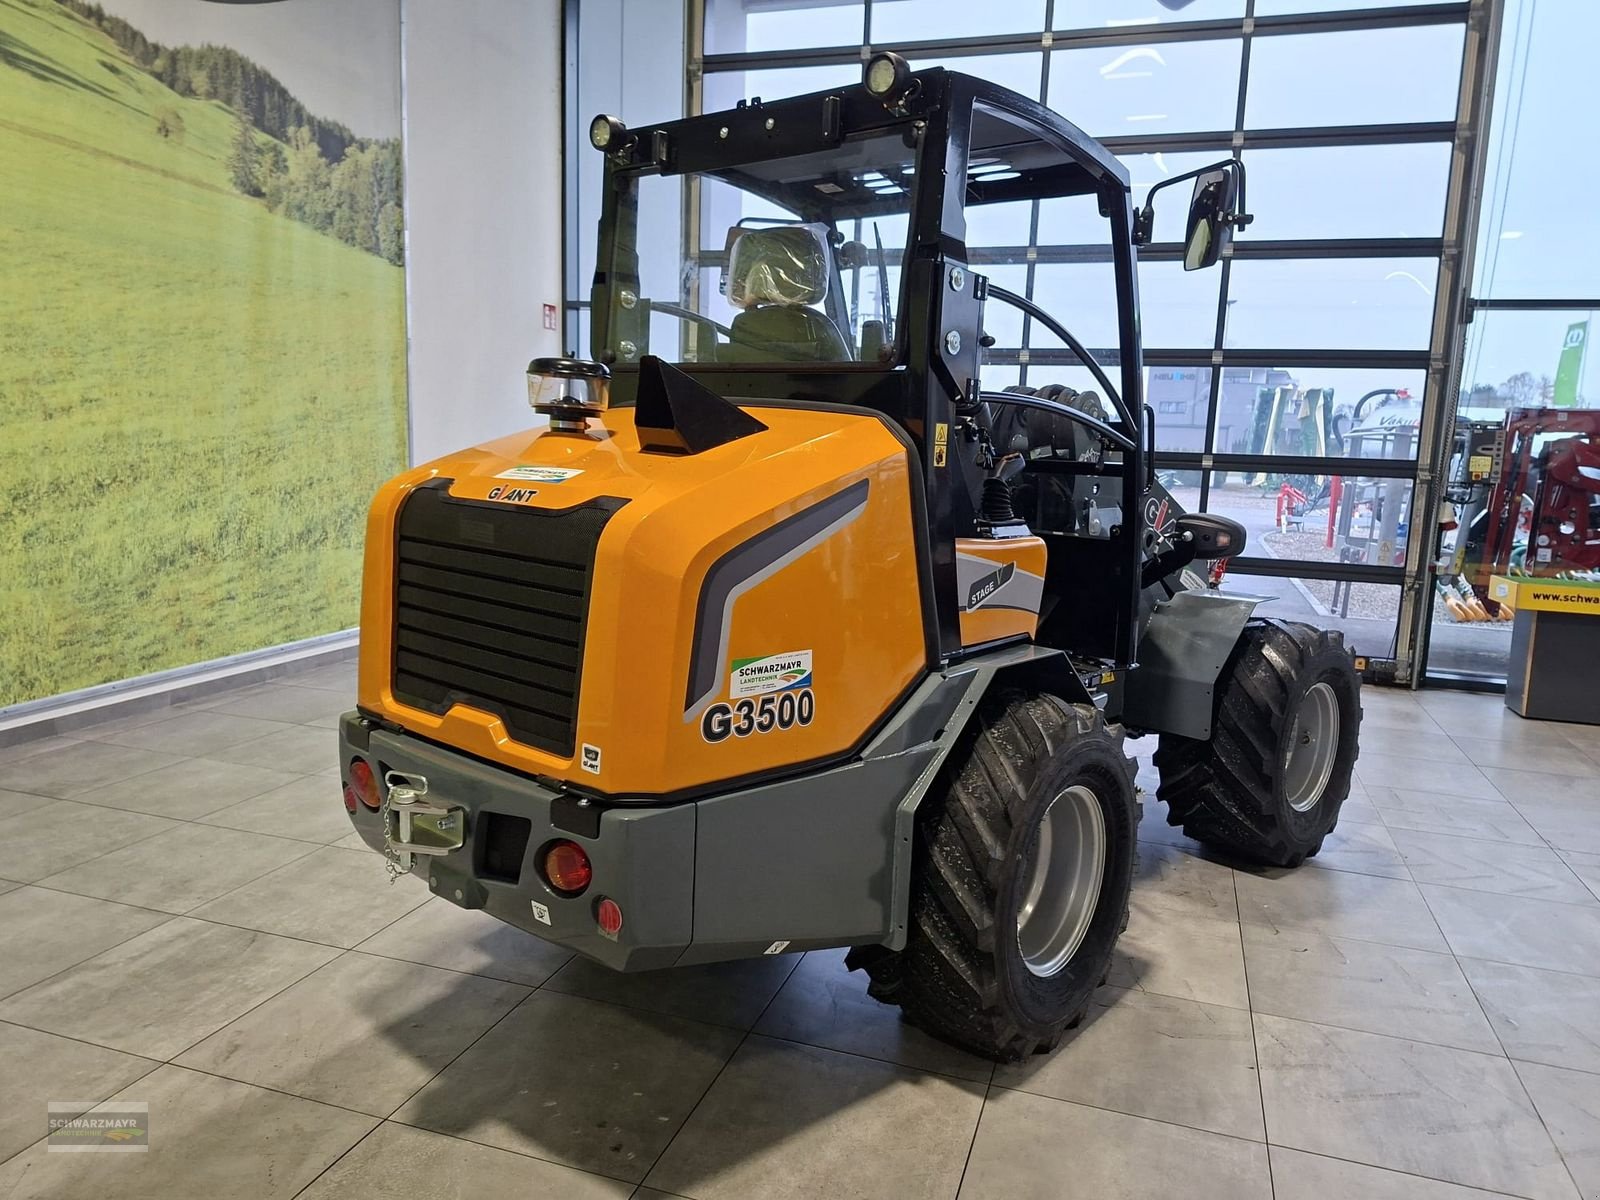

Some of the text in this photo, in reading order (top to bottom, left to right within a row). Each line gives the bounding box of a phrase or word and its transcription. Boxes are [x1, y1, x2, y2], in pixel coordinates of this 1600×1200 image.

[488, 484, 538, 503] GIANT
[971, 581, 995, 604] STAGE
[739, 660, 802, 677] SCHWARZMAYR
[739, 674, 778, 685] LANDTECHNIK
[702, 688, 815, 746] G3500
